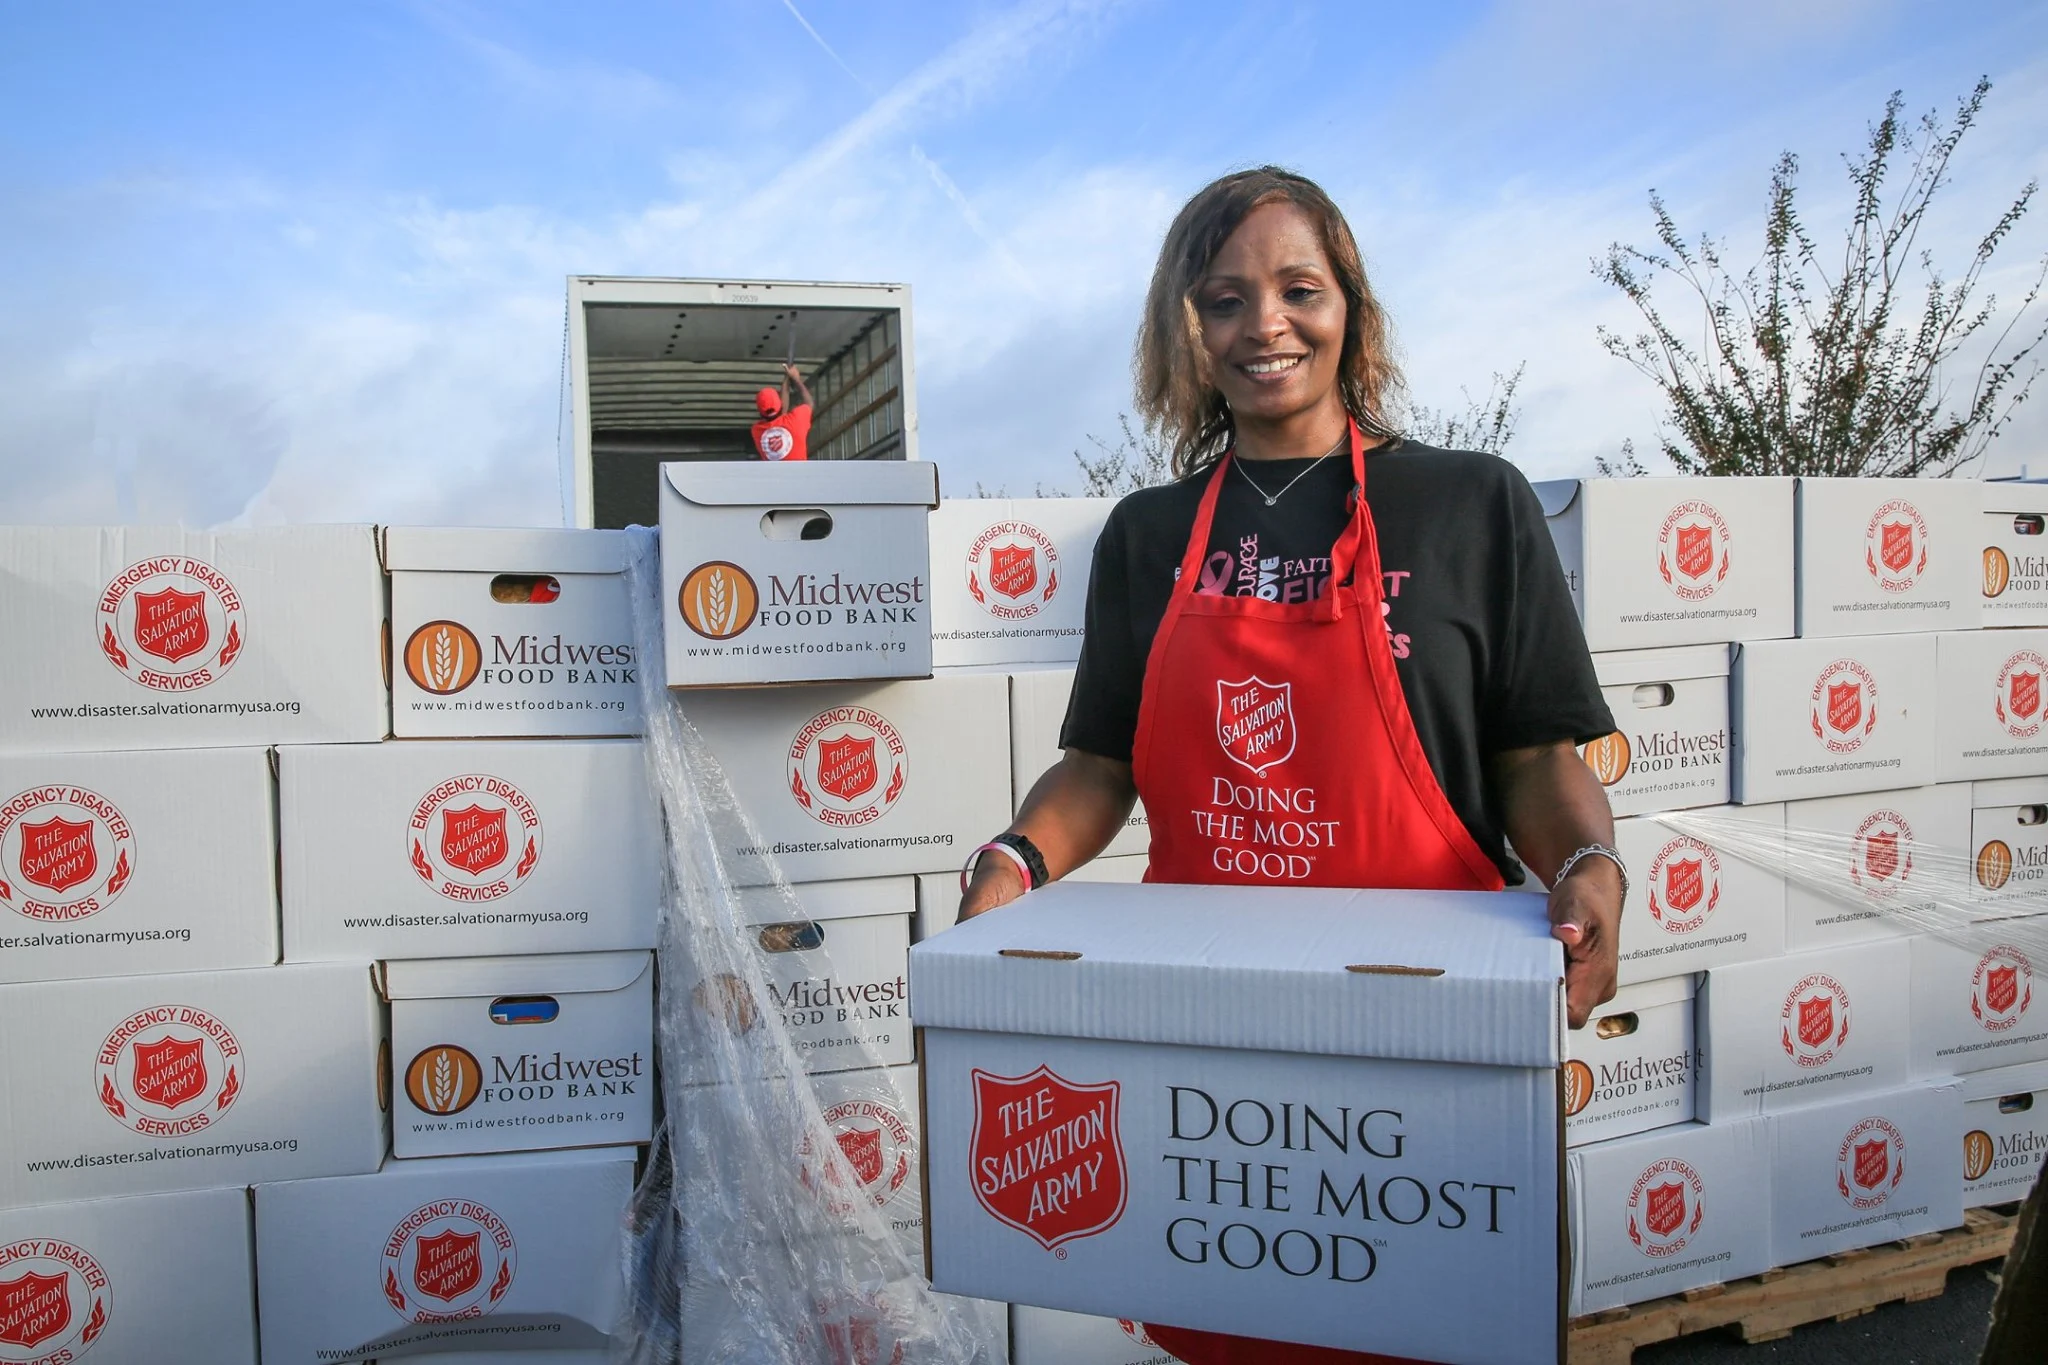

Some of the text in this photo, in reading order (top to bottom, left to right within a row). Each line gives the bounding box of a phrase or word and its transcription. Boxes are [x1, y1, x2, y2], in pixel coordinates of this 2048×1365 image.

[1660, 502, 1730, 544] EMERGENCY DISASTER
[1867, 502, 1927, 539] EMERGENCY DISASTER
[969, 523, 1058, 563] EMERGENCY DISASTER
[1678, 534, 1710, 567] SALVATION
[1683, 532, 1698, 548] THE
[993, 554, 1032, 586] SALVATION
[999, 552, 1016, 568] THE
[1236, 533, 1258, 597] OURAGE
[1284, 558, 1331, 579] FAIT
[1690, 550, 1709, 573] ARMY
[102, 558, 240, 614] EMERGENCY DISASTER
[768, 573, 923, 606] Midwest
[1008, 570, 1031, 592] ARMY
[1256, 556, 1280, 602] OVE
[1676, 584, 1714, 600] SERVICES
[1881, 578, 1913, 592] SERVICES
[149, 598, 176, 620] THE
[760, 607, 917, 627] FOOD BANK
[991, 604, 1038, 619] SERVICES
[1620, 608, 1757, 623] www.disaster.salvationarmyusa.org
[1833, 600, 1950, 612] www.disaster.salvationarmyusa.org
[141, 602, 200, 645] SALVATION
[164, 622, 199, 654] ARMY
[688, 640, 906, 656] www.midwestfoodbank.org
[138, 669, 212, 690] SERVICES
[483, 668, 636, 684] FOOD BANK
[1813, 661, 1876, 700] EMERGENCY DISASTER
[31, 701, 301, 718] www.disaster.salvationarmyusa.org
[412, 700, 625, 712] www.midwestfoodbank.org
[1231, 687, 1259, 716] THE
[792, 709, 903, 760] EMERGENCY DISASTER
[1222, 693, 1286, 747] SALVATION
[830, 744, 852, 764] THE
[1245, 720, 1284, 760] ARMY
[1636, 729, 1725, 758] Midwest
[1827, 738, 1861, 752] SERVICES
[823, 747, 870, 787] SALVATION
[1632, 752, 1722, 774] FOOD BANK
[1776, 758, 1900, 776] www.disaster.salvationarmyusa.org
[840, 765, 870, 794] ARMY
[1212, 776, 1316, 814] DOING
[1607, 778, 1716, 798] .midwestfoodbank.org
[0, 788, 130, 842] ERGENCY DISASTER
[412, 777, 538, 830] EMERGENCY DISASTER
[819, 806, 879, 825] SERVICES
[35, 828, 64, 852] THE
[446, 817, 501, 859] SALVATION
[454, 814, 479, 836] THE
[1192, 810, 1340, 847] THE MOST
[26, 830, 88, 876] SALVATION
[50, 852, 88, 884] ARMY
[466, 837, 500, 868] ARMY
[1214, 847, 1311, 878] GOOD
[1650, 837, 1720, 882] EMERGENCY DISASTER
[442, 881, 508, 900] SERVICES
[1669, 868, 1700, 902] SALVATION
[1674, 866, 1688, 884] THE
[22, 898, 100, 920] SERVICES
[1680, 882, 1699, 907] ARMY
[344, 910, 588, 928] www.disaster.salvationarmyusa.org
[1666, 915, 1704, 932] SERVICES
[766, 976, 906, 1009] Midwest
[1783, 976, 1848, 1018] EMERGENCY DISASTER
[837, 1004, 900, 1022] BANK
[100, 1008, 238, 1066] EMERGENCY DISASTER
[140, 1048, 199, 1094] SALVATION
[148, 1047, 174, 1070] THE
[492, 1052, 642, 1084] Midwest
[1600, 1050, 1691, 1087] Midwest
[1798, 1050, 1833, 1066] SERVICES
[162, 1068, 198, 1101] ARMY
[484, 1080, 636, 1102] FOOD BANK
[1594, 1072, 1686, 1102] FOOD BANK
[1743, 1065, 1873, 1096] www.disaster.salvationarmyusa.org
[136, 1113, 210, 1135] SERVICES
[412, 1110, 625, 1132] www.midwestfoodbank.org
[862, 1104, 908, 1146] DISASTER
[998, 1089, 1055, 1138] THE
[1166, 1085, 1406, 1160] DOING
[1566, 1098, 1680, 1128] w.midwestfoodbank.org
[27, 1138, 298, 1172] www.disaster.salvationarmyusa.org
[981, 1099, 1106, 1196] SALVATION
[1839, 1119, 1904, 1162] EMERGENCY DISASTER
[1994, 1154, 2028, 1170] FOOD
[1027, 1154, 1104, 1223] ARMY
[1163, 1154, 1516, 1235] THE MOST
[1629, 1160, 1702, 1208] EMERGENCY DISASTER
[1654, 1190, 1668, 1207] THE
[1650, 1190, 1681, 1227] SALVATION
[1853, 1192, 1887, 1208] SERVICES
[386, 1202, 512, 1258] EMERGENCY DISASTER
[1661, 1206, 1680, 1232] ARMY
[1800, 1206, 1928, 1239] www.disaster.salvationarmyusa.org
[428, 1240, 452, 1262] THE
[1166, 1217, 1377, 1284] GOOD
[1646, 1238, 1686, 1256] SERVICES
[44, 1242, 106, 1291] DISASTER
[419, 1242, 474, 1287] SALVATION
[440, 1262, 473, 1294] ARMY
[1586, 1251, 1730, 1291] www.disaster.salvationarmyusa.org
[6, 1283, 36, 1308] THE
[20, 1304, 60, 1340] ARMY
[414, 1306, 482, 1324] SERVICES
[316, 1322, 560, 1360] www.disaster.salvationarmyusa.org
